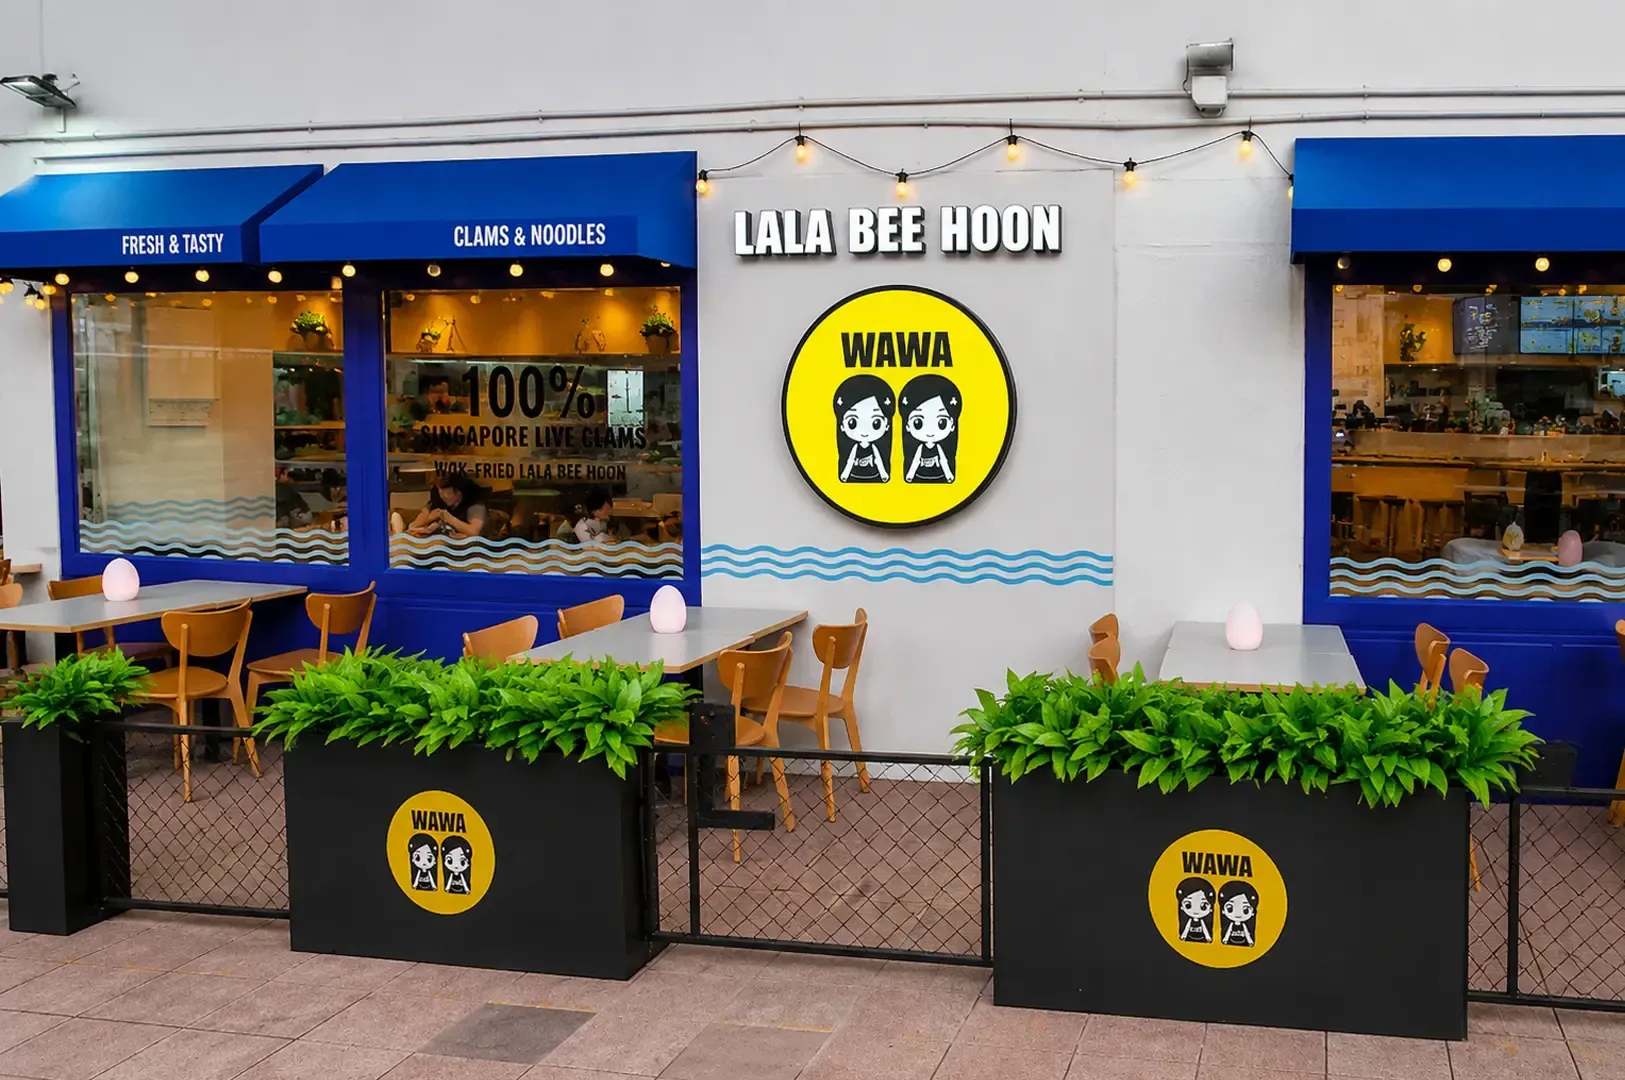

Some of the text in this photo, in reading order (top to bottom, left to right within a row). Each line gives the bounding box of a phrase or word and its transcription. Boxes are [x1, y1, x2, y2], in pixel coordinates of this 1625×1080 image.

[453, 223, 606, 248] CLAMS & NOODLES
[734, 204, 1062, 256] LALA BEE HOON
[121, 233, 224, 255] FRESH & TASTY
[841, 331, 953, 368] WAWA
[462, 365, 596, 419] 100%
[420, 424, 647, 449] SINGAPORE LIVE CLAMS
[434, 460, 626, 481] WOK-FRIED LALA BEE HOON
[411, 809, 467, 834] WAWA
[1182, 851, 1253, 878] WAWA
